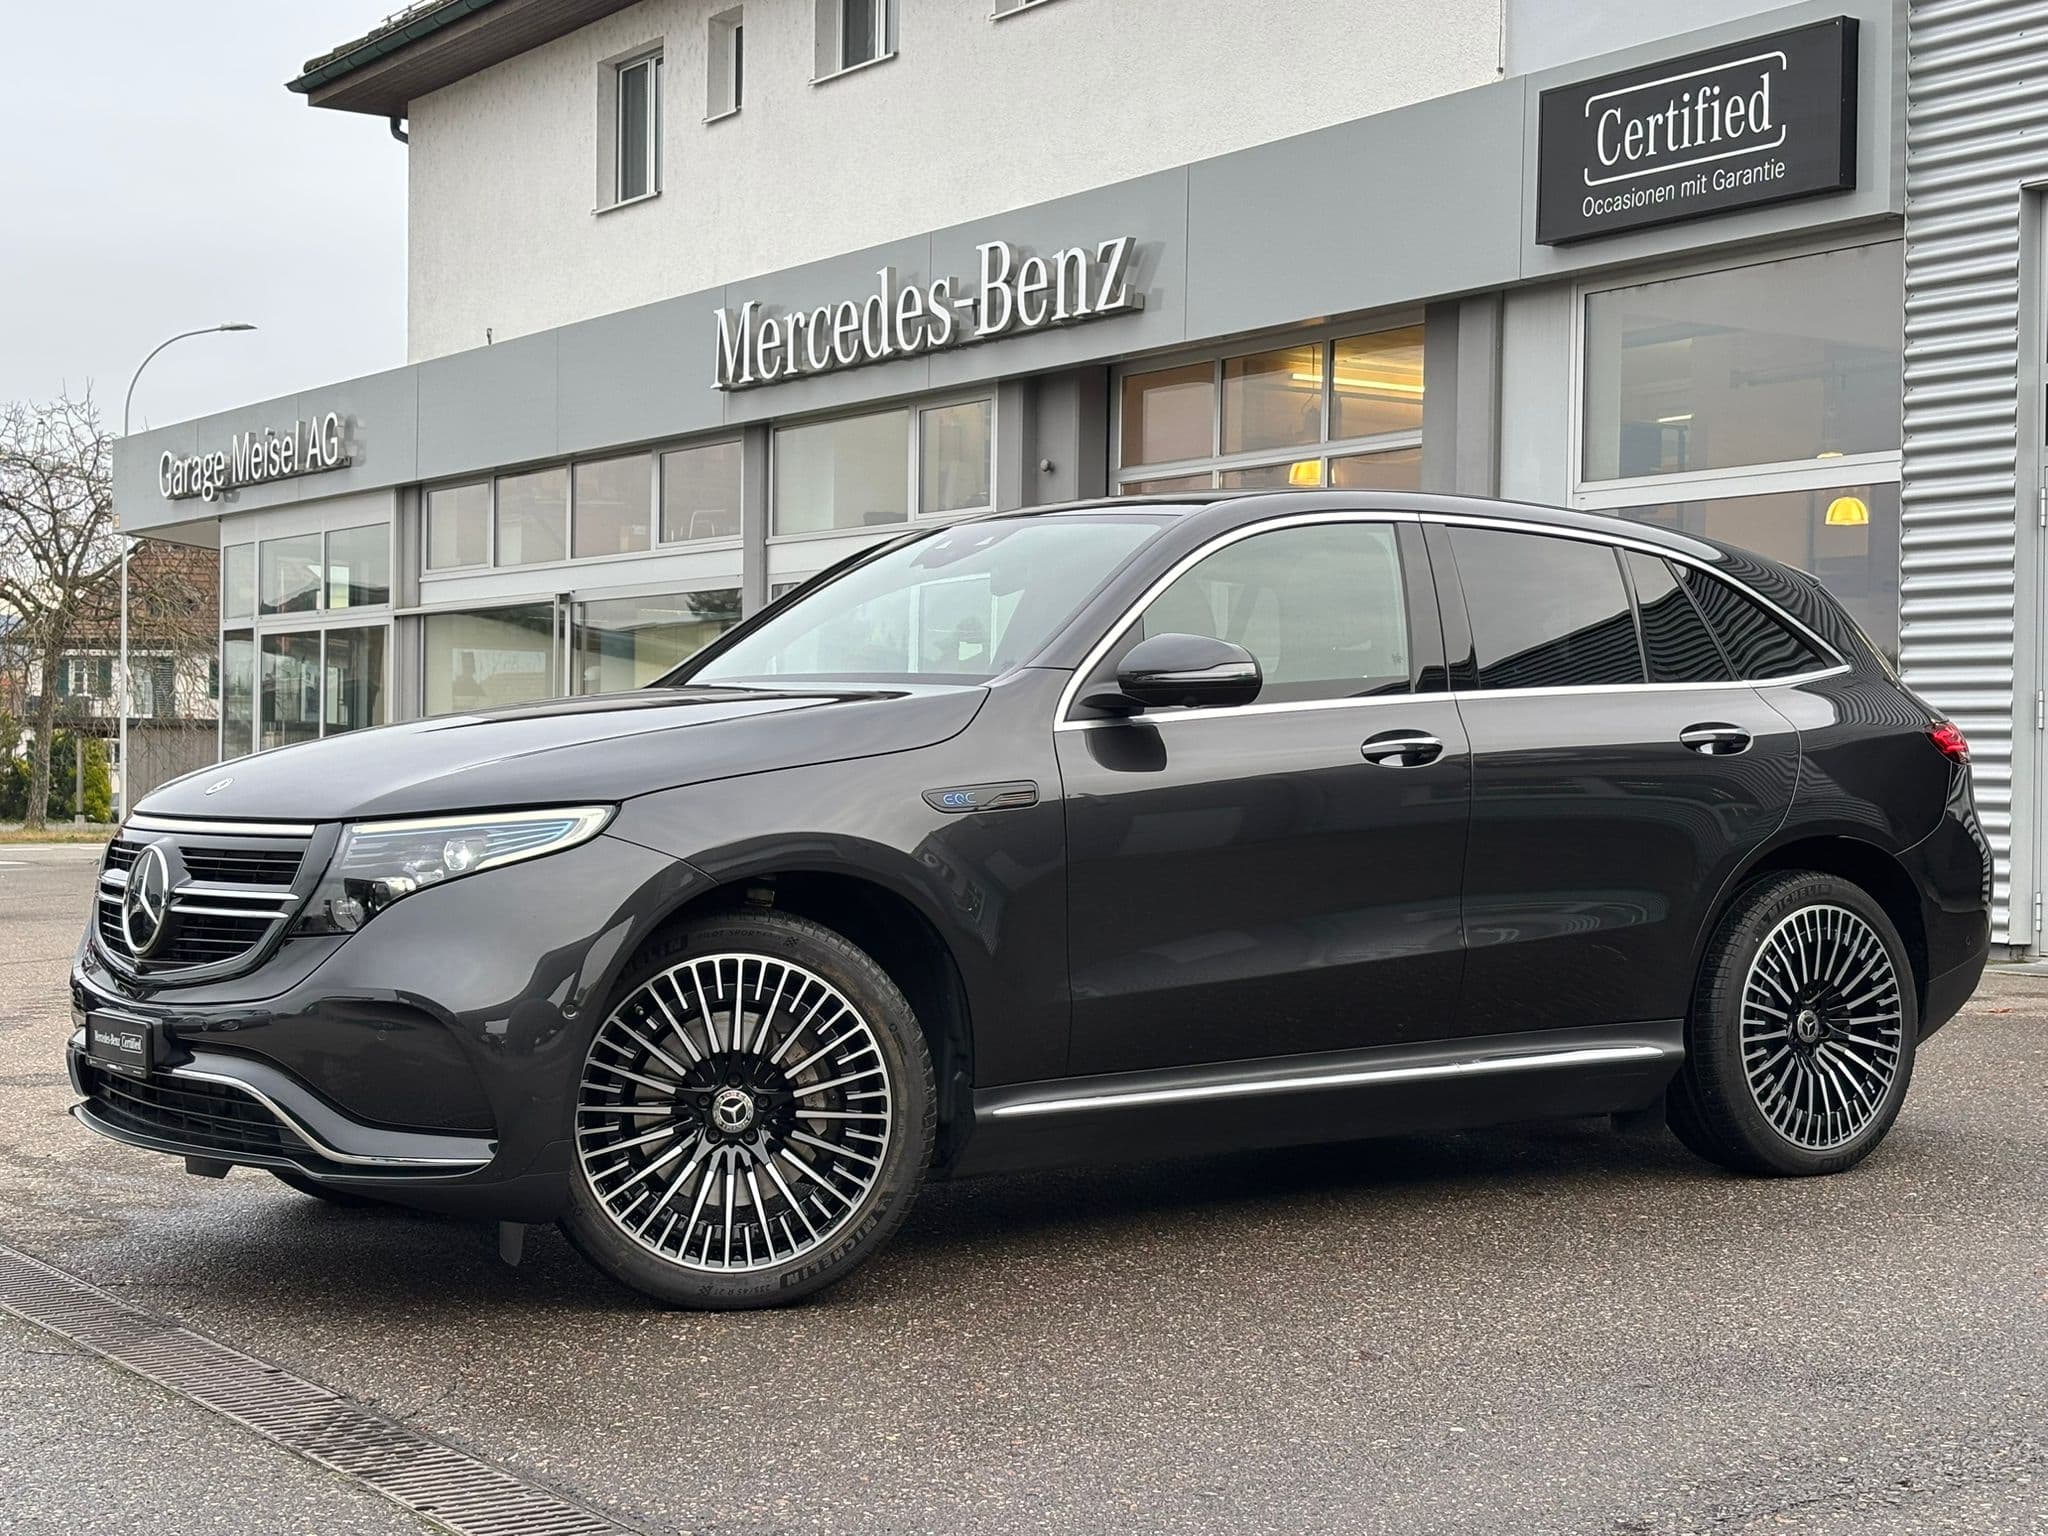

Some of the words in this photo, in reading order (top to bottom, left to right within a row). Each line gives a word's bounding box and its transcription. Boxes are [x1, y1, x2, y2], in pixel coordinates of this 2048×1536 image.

[1596, 71, 1773, 166] Certified
[1582, 184, 1675, 218] Occasionen
[1680, 174, 1707, 199] mit
[1712, 158, 1786, 191] Garantie
[710, 236, 1140, 390] Mercedes-Benz
[159, 450, 226, 502] Garage
[231, 420, 302, 484] Meisel
[305, 411, 339, 470] AG
[942, 791, 978, 806] EQC
[786, 1214, 879, 1287] MICHELIN
